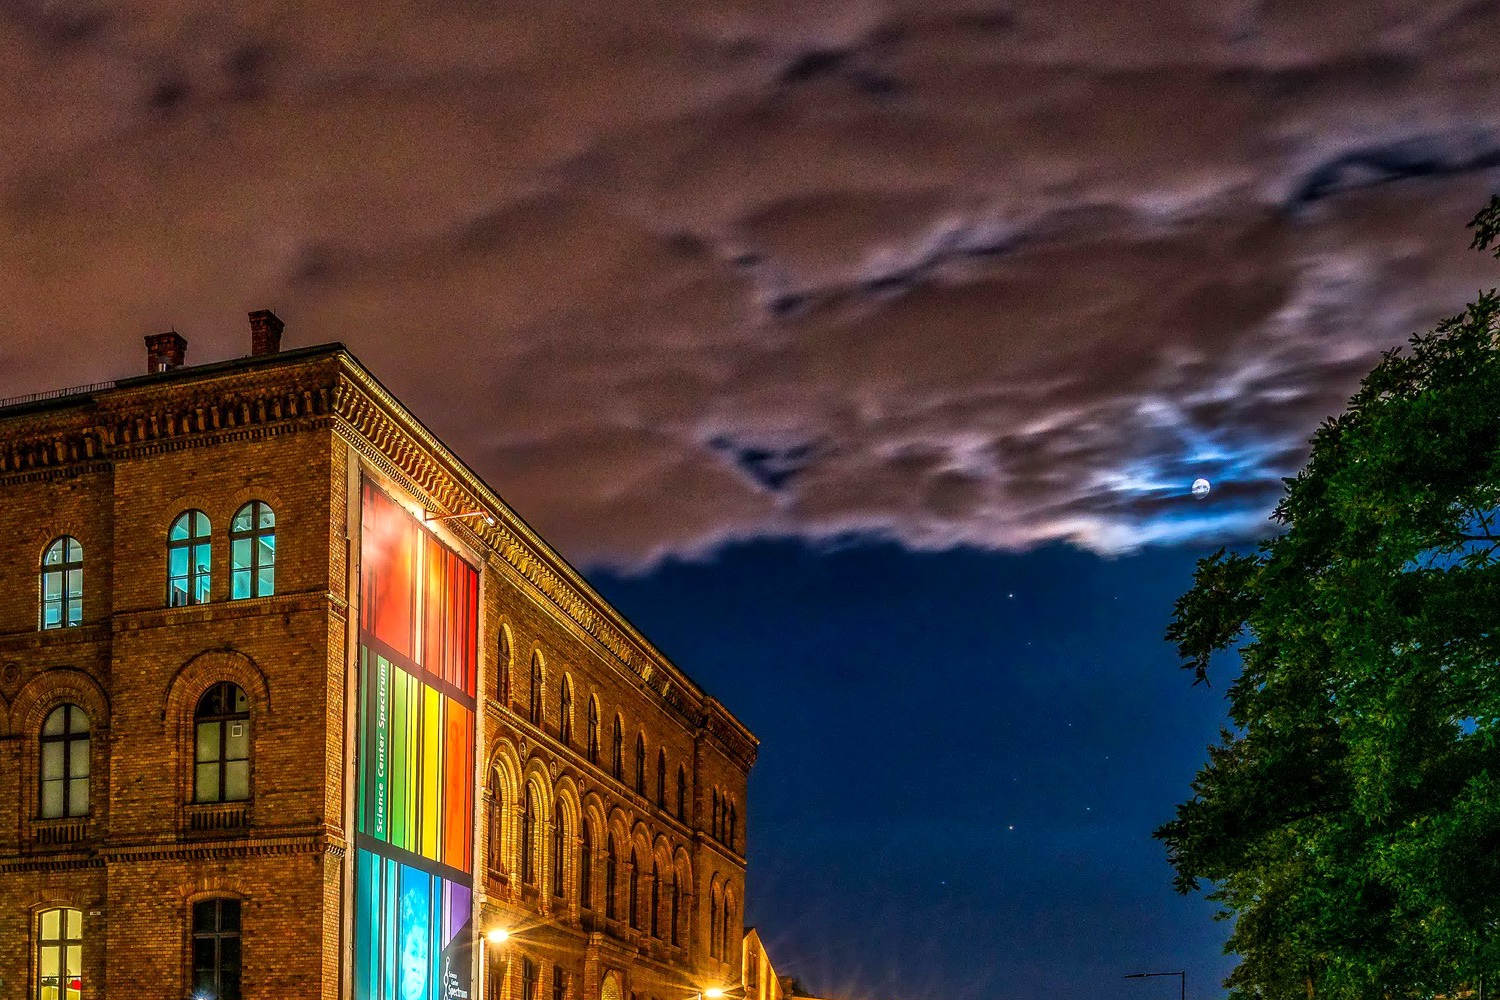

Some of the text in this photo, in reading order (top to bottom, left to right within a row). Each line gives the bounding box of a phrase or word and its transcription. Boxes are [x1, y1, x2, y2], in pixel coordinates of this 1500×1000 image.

[376, 664, 386, 834] Science Center Spectrum
[448, 984, 468, 998] Spectrum
